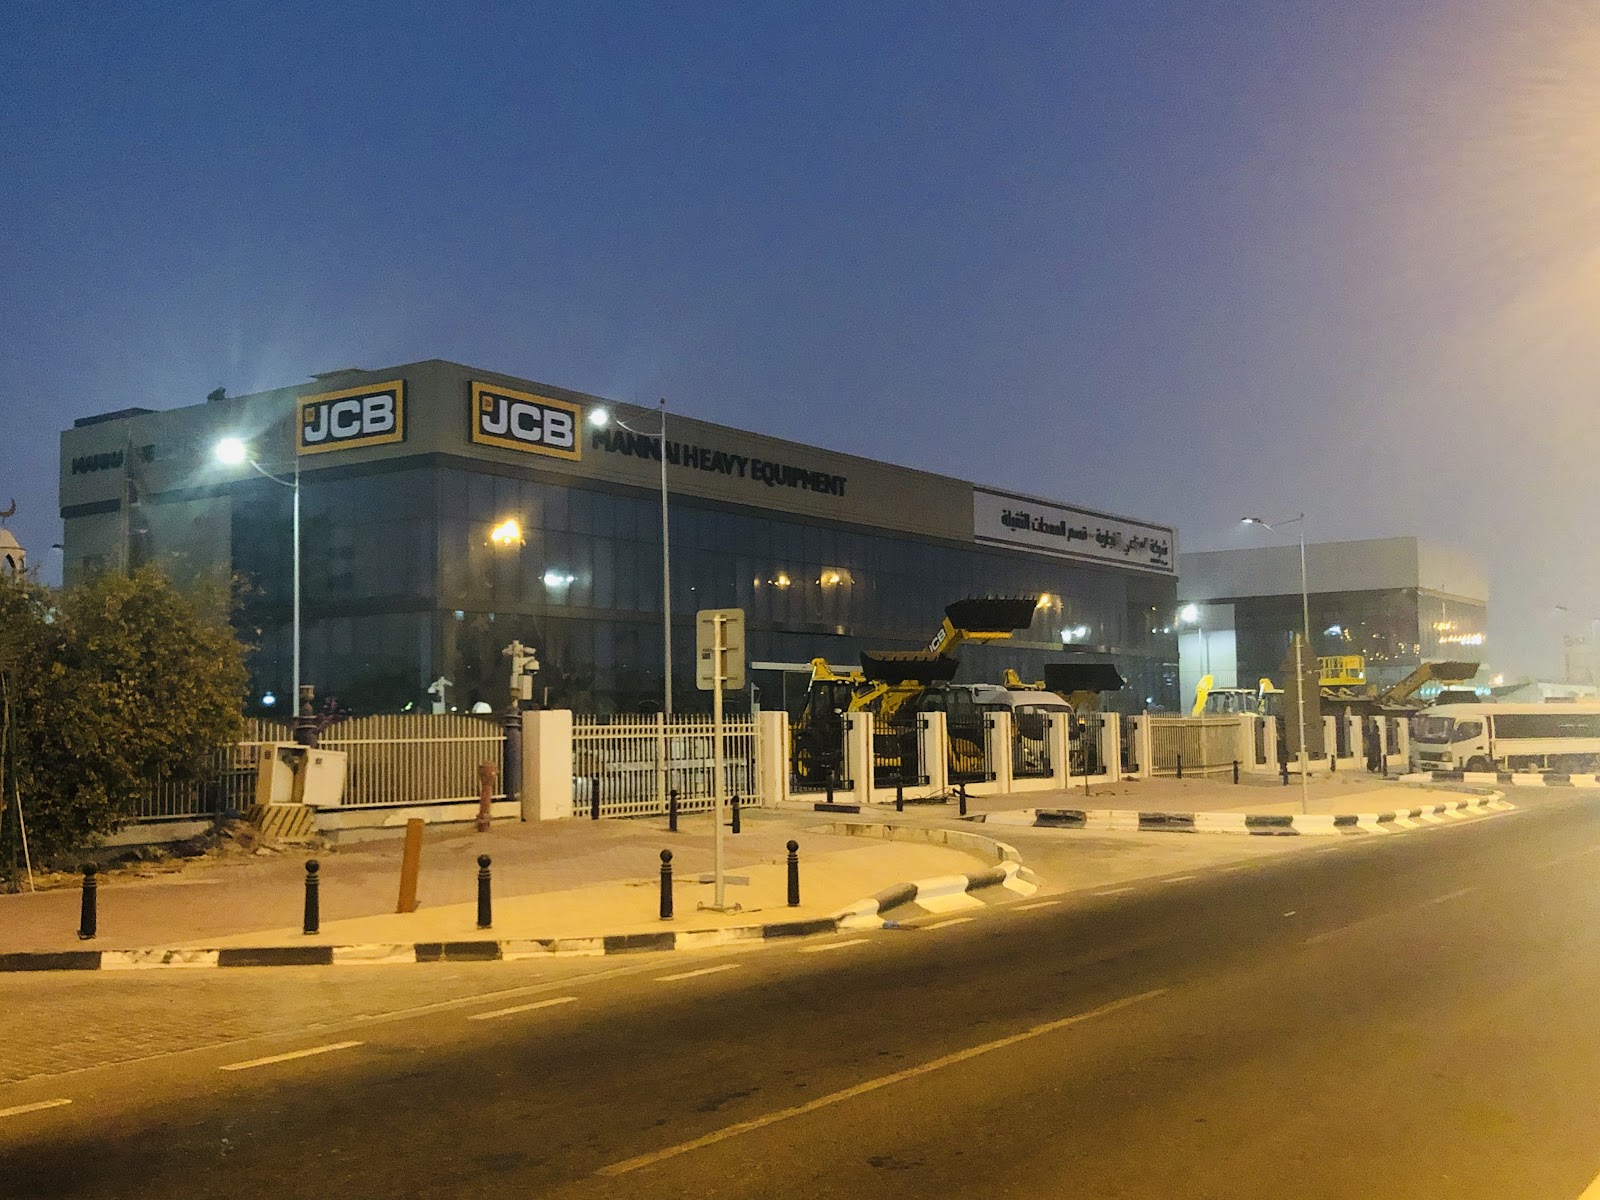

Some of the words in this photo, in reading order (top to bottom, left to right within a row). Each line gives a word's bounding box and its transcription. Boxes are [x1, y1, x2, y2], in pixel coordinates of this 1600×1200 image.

[305, 395, 394, 442] JCB
[481, 399, 574, 447] JCB
[683, 444, 749, 477] HEAVY
[751, 458, 847, 496] EQUIPMENT
